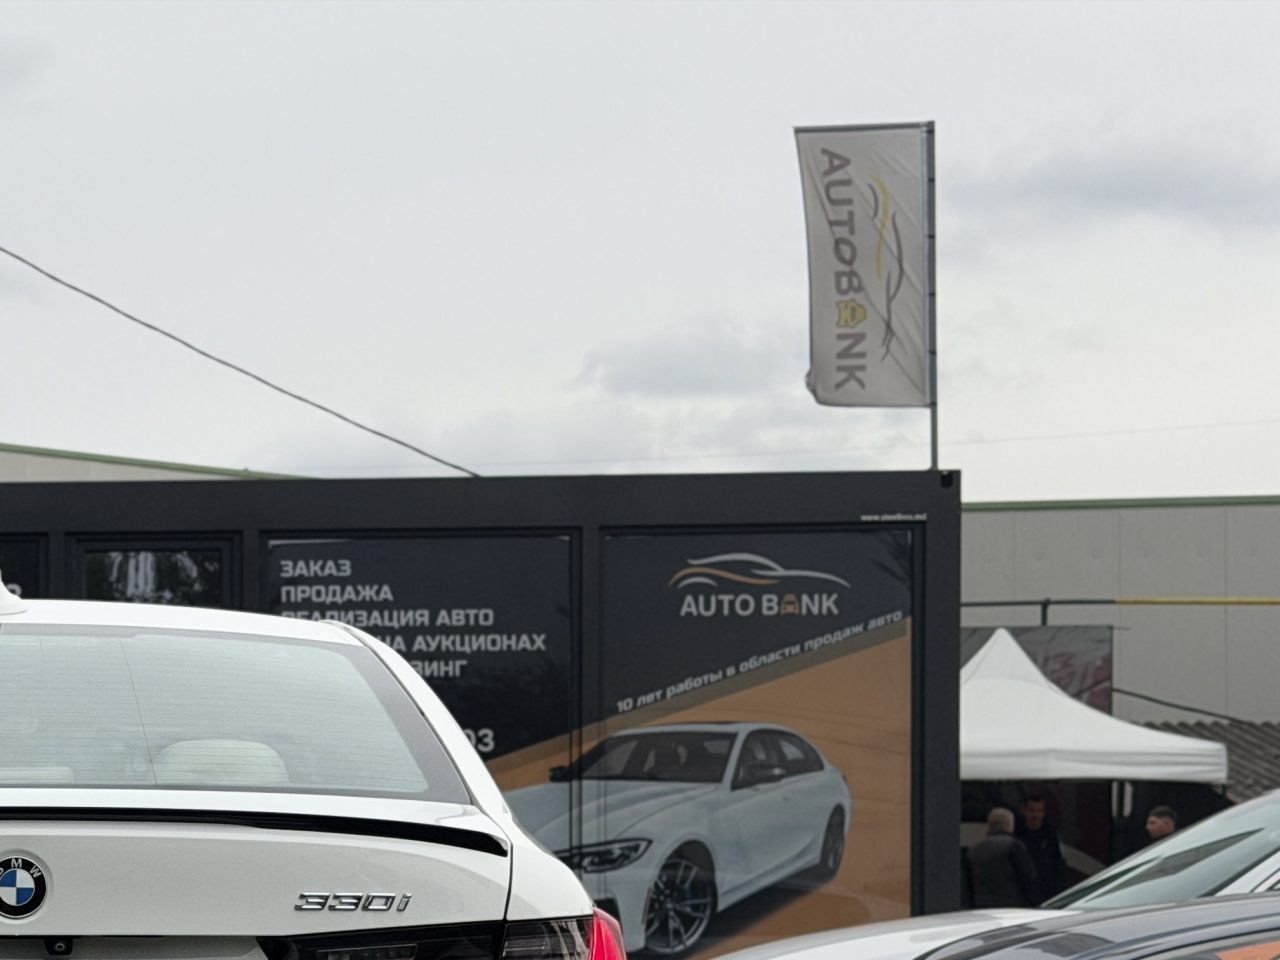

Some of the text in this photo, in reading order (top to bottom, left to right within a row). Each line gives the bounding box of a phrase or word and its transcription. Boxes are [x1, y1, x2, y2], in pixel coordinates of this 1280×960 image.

[280, 560, 352, 577] ЗАКАЗ
[281, 585, 394, 604] ПРОДАЖА
[680, 594, 754, 616] AUTO
[436, 609, 494, 626] АВТО
[412, 634, 546, 654] АУКЦИОНАХ
[410, 660, 468, 677] ЗИНГ
[617, 610, 903, 712] 10 лет работы в области продаж авто
[294, 892, 412, 912] 330i
